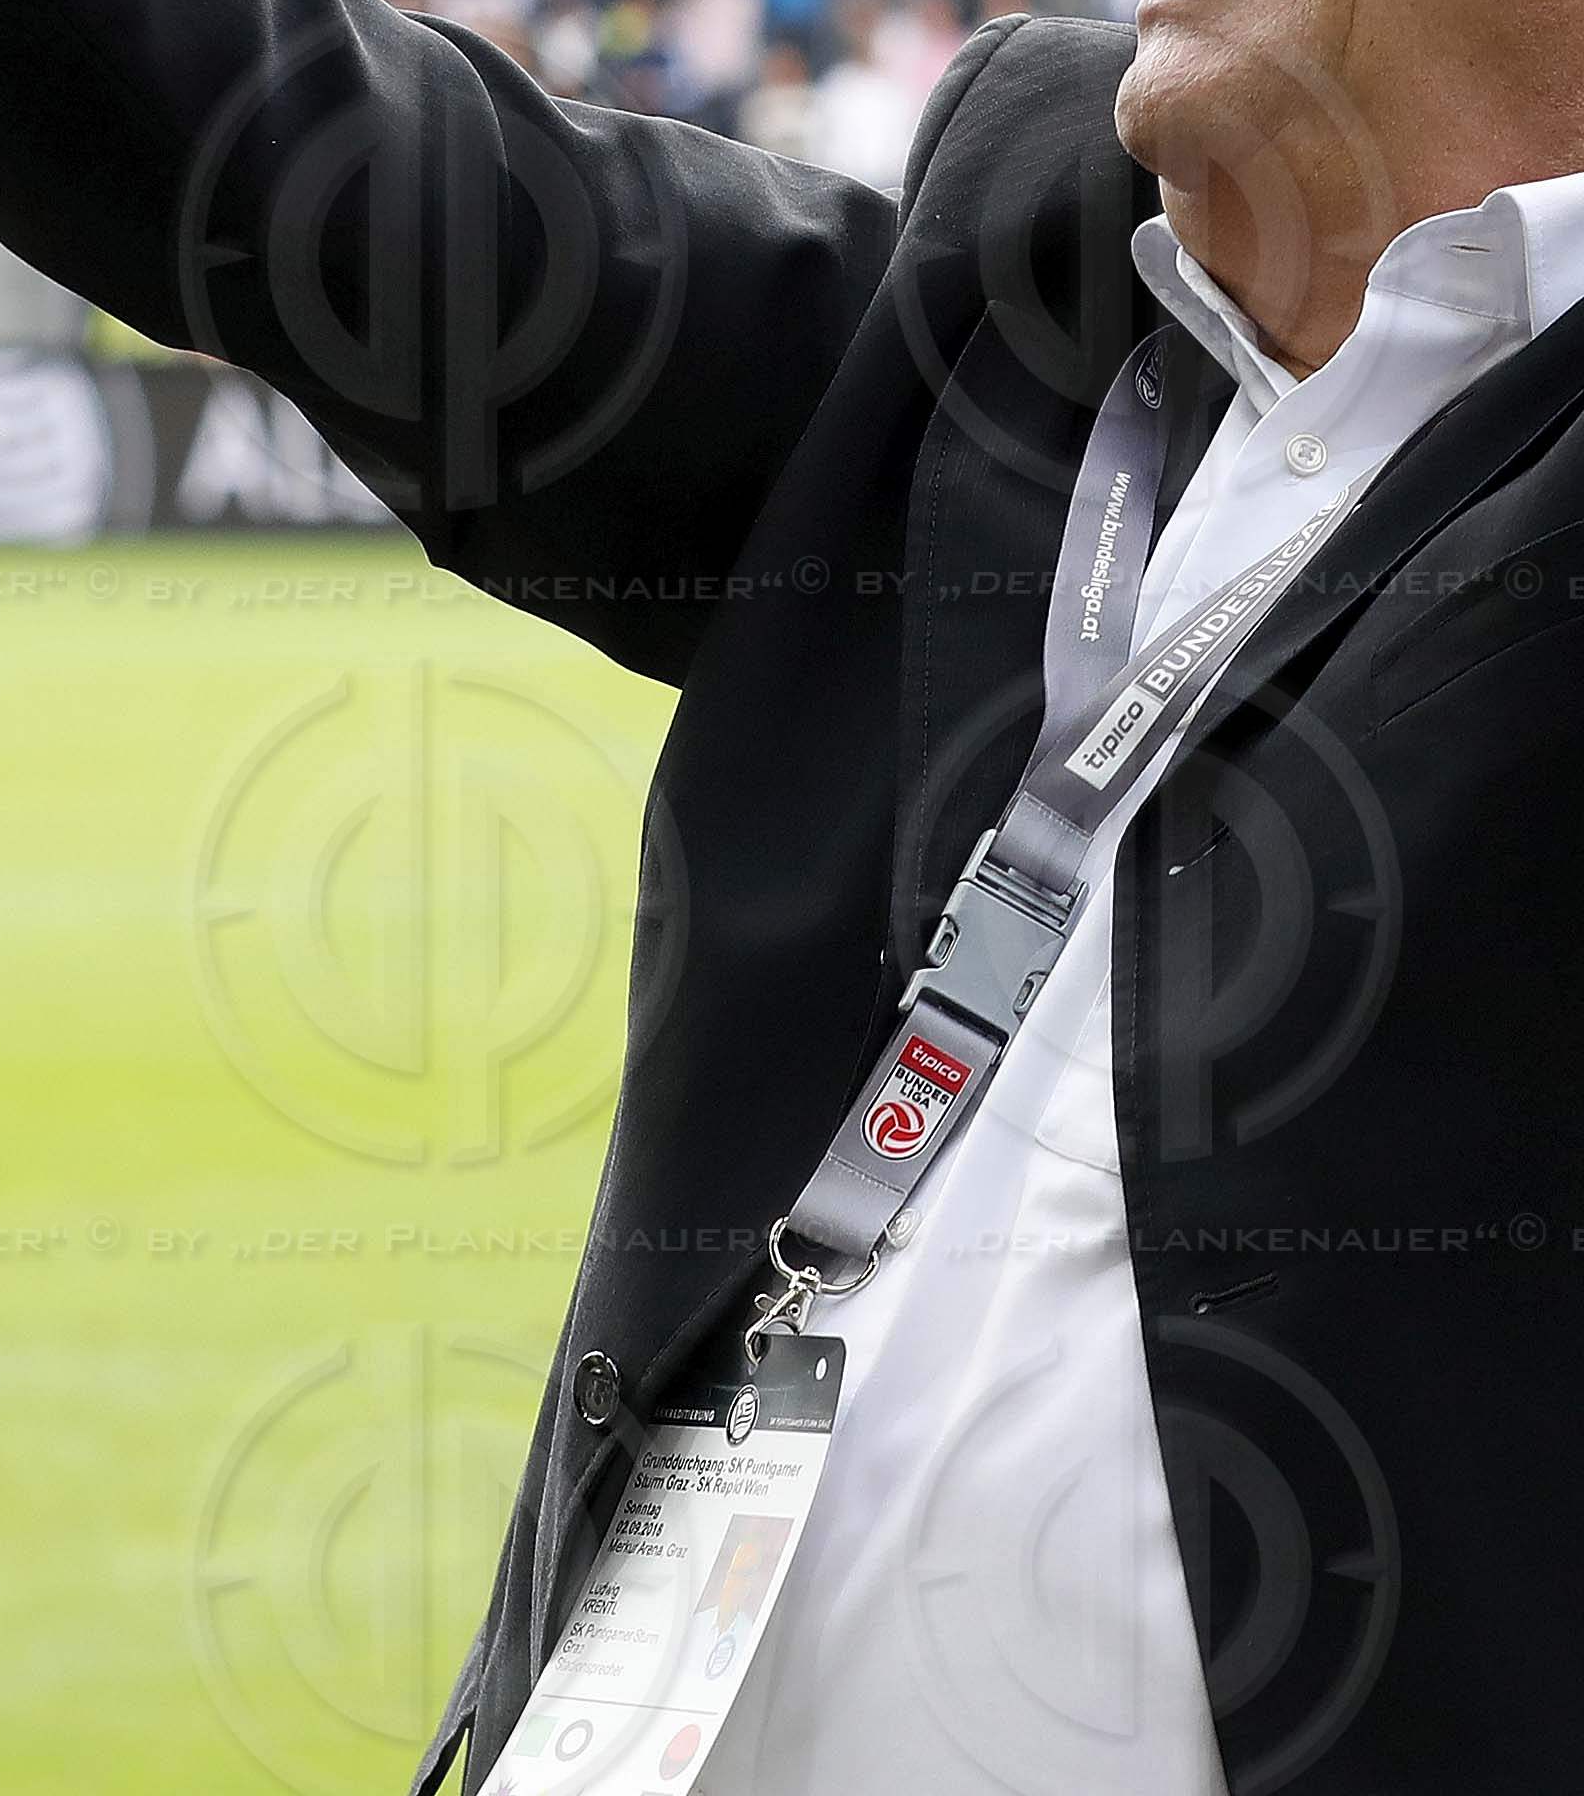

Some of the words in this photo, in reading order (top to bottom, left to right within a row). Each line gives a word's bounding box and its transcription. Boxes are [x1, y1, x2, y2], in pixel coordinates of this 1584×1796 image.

[1080, 471, 1132, 643] www.bundesliga.at
[1082, 699, 1145, 771] tipico
[1143, 519, 1325, 695] BUNDESLIGA
[911, 1044, 962, 1083] tipico
[894, 1066, 951, 1105] BUNDES
[899, 1084, 931, 1110] LIGA
[634, 1473, 665, 1490] Sturm
[666, 1475, 689, 1492] Graz
[623, 1500, 663, 1519] Sonntag
